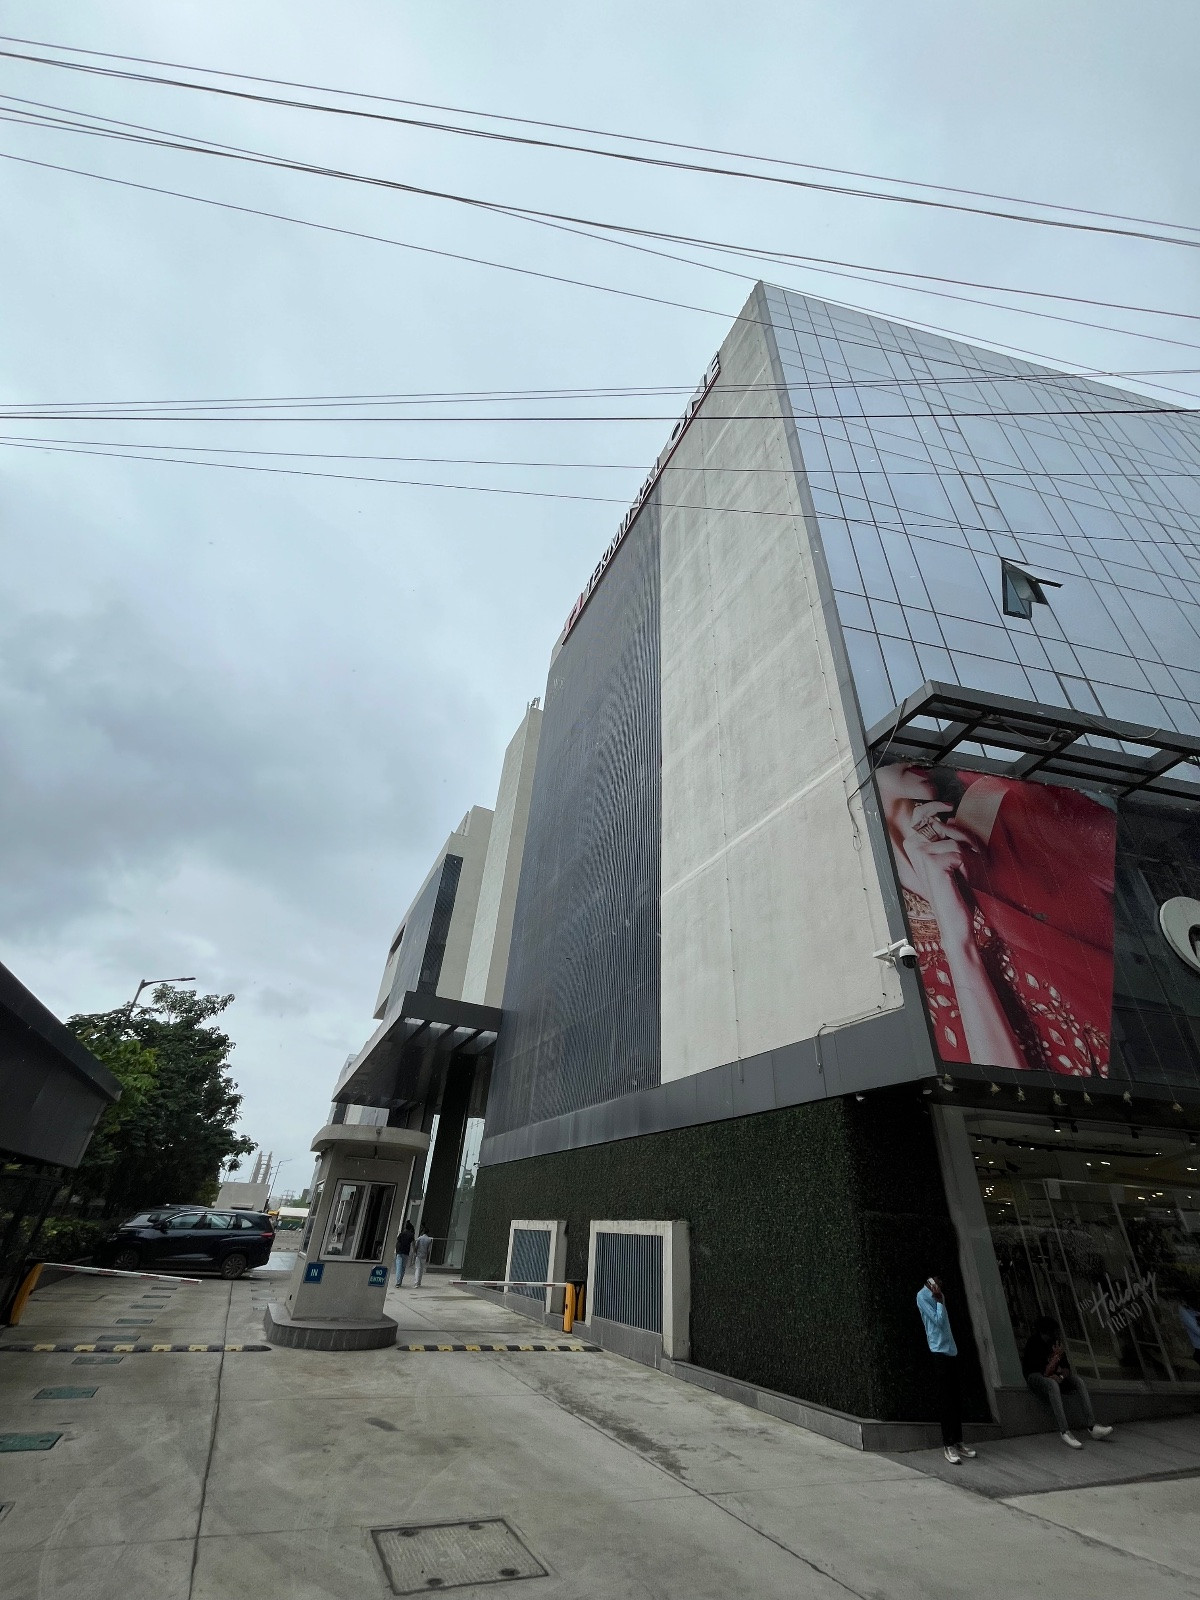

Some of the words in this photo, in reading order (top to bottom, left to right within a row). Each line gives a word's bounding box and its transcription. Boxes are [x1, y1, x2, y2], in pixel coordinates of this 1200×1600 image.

[667, 351, 721, 450] ONE
[310, 1268, 319, 1277] IN
[1090, 1266, 1157, 1328] Holiday
[1105, 1302, 1142, 1335] TREND
